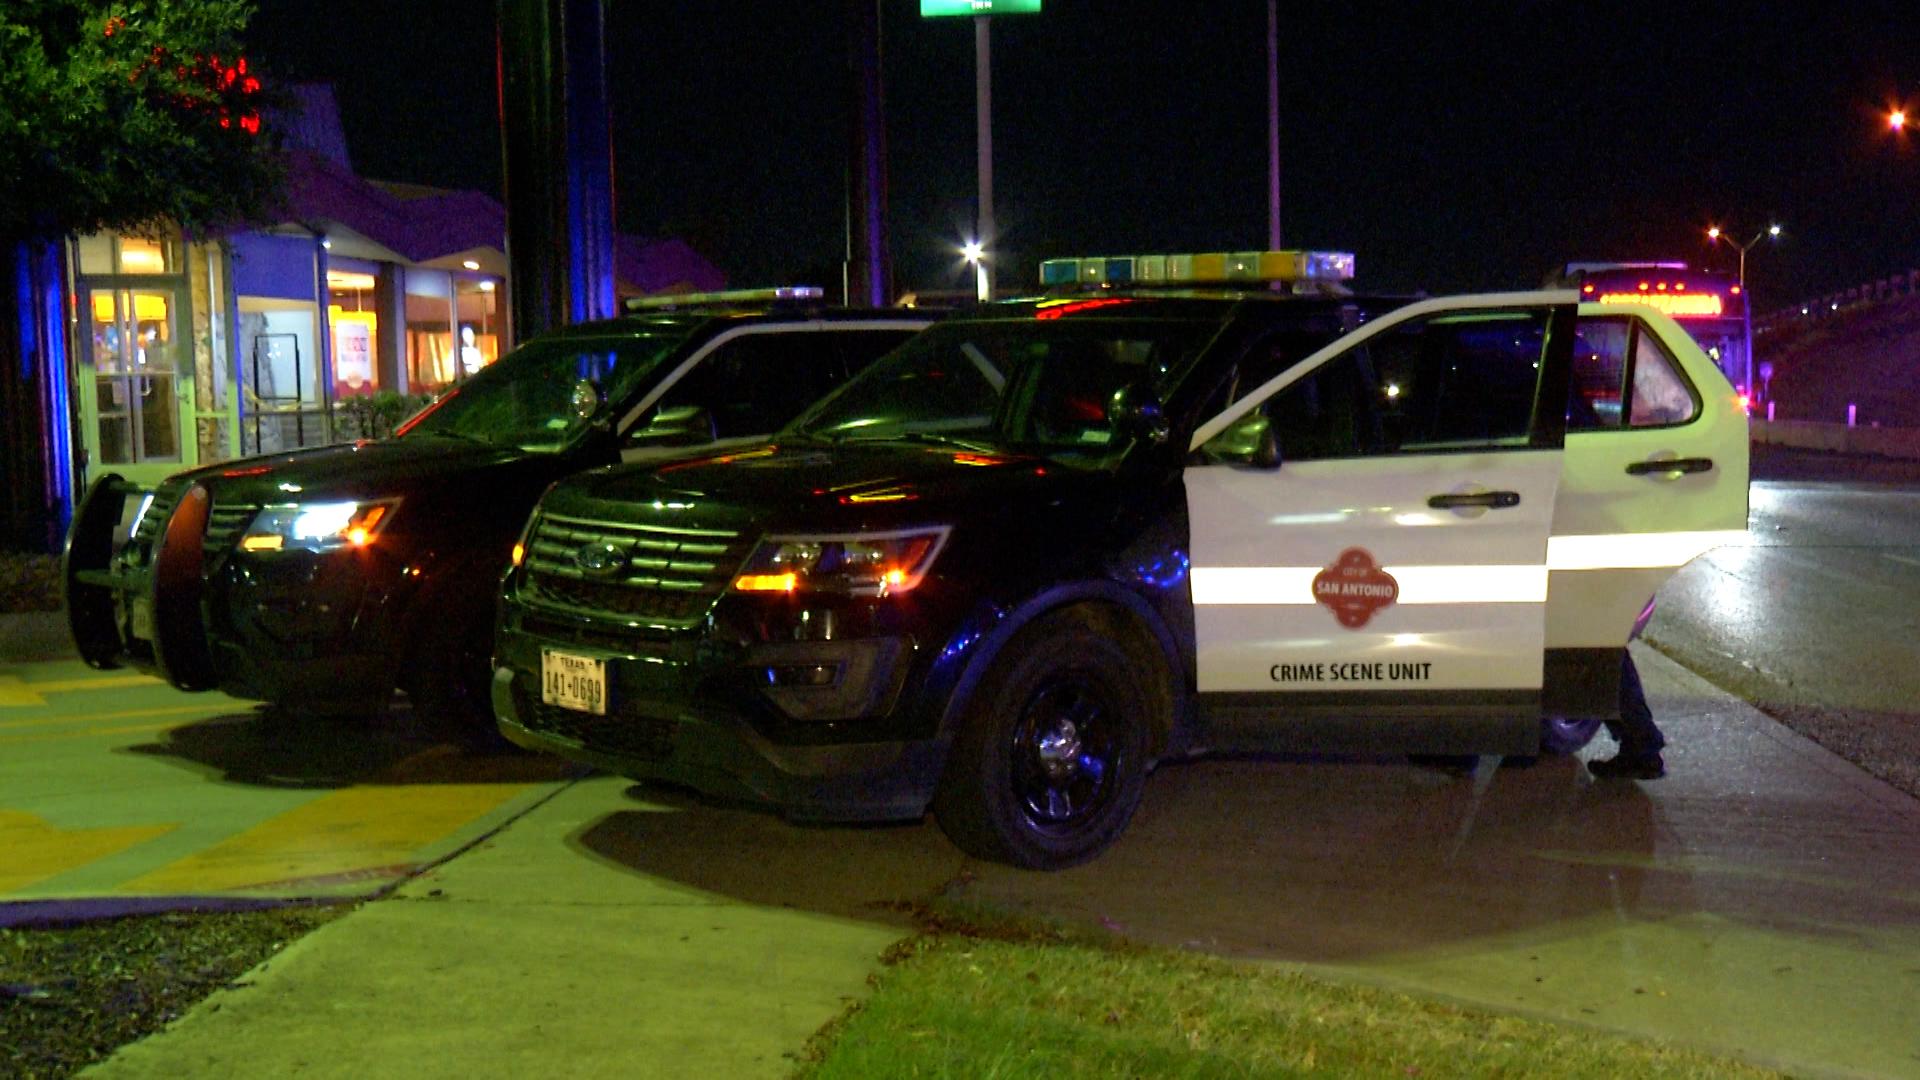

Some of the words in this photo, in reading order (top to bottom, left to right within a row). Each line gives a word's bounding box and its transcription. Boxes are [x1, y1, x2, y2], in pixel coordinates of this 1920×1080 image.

[1316, 581, 1339, 595] SAN
[1341, 583, 1393, 597] ANTONIO
[560, 657, 585, 669] TEXAS
[1270, 663, 1325, 682] CRIME
[1329, 663, 1384, 681] SCENE
[1388, 663, 1432, 680] UNIT
